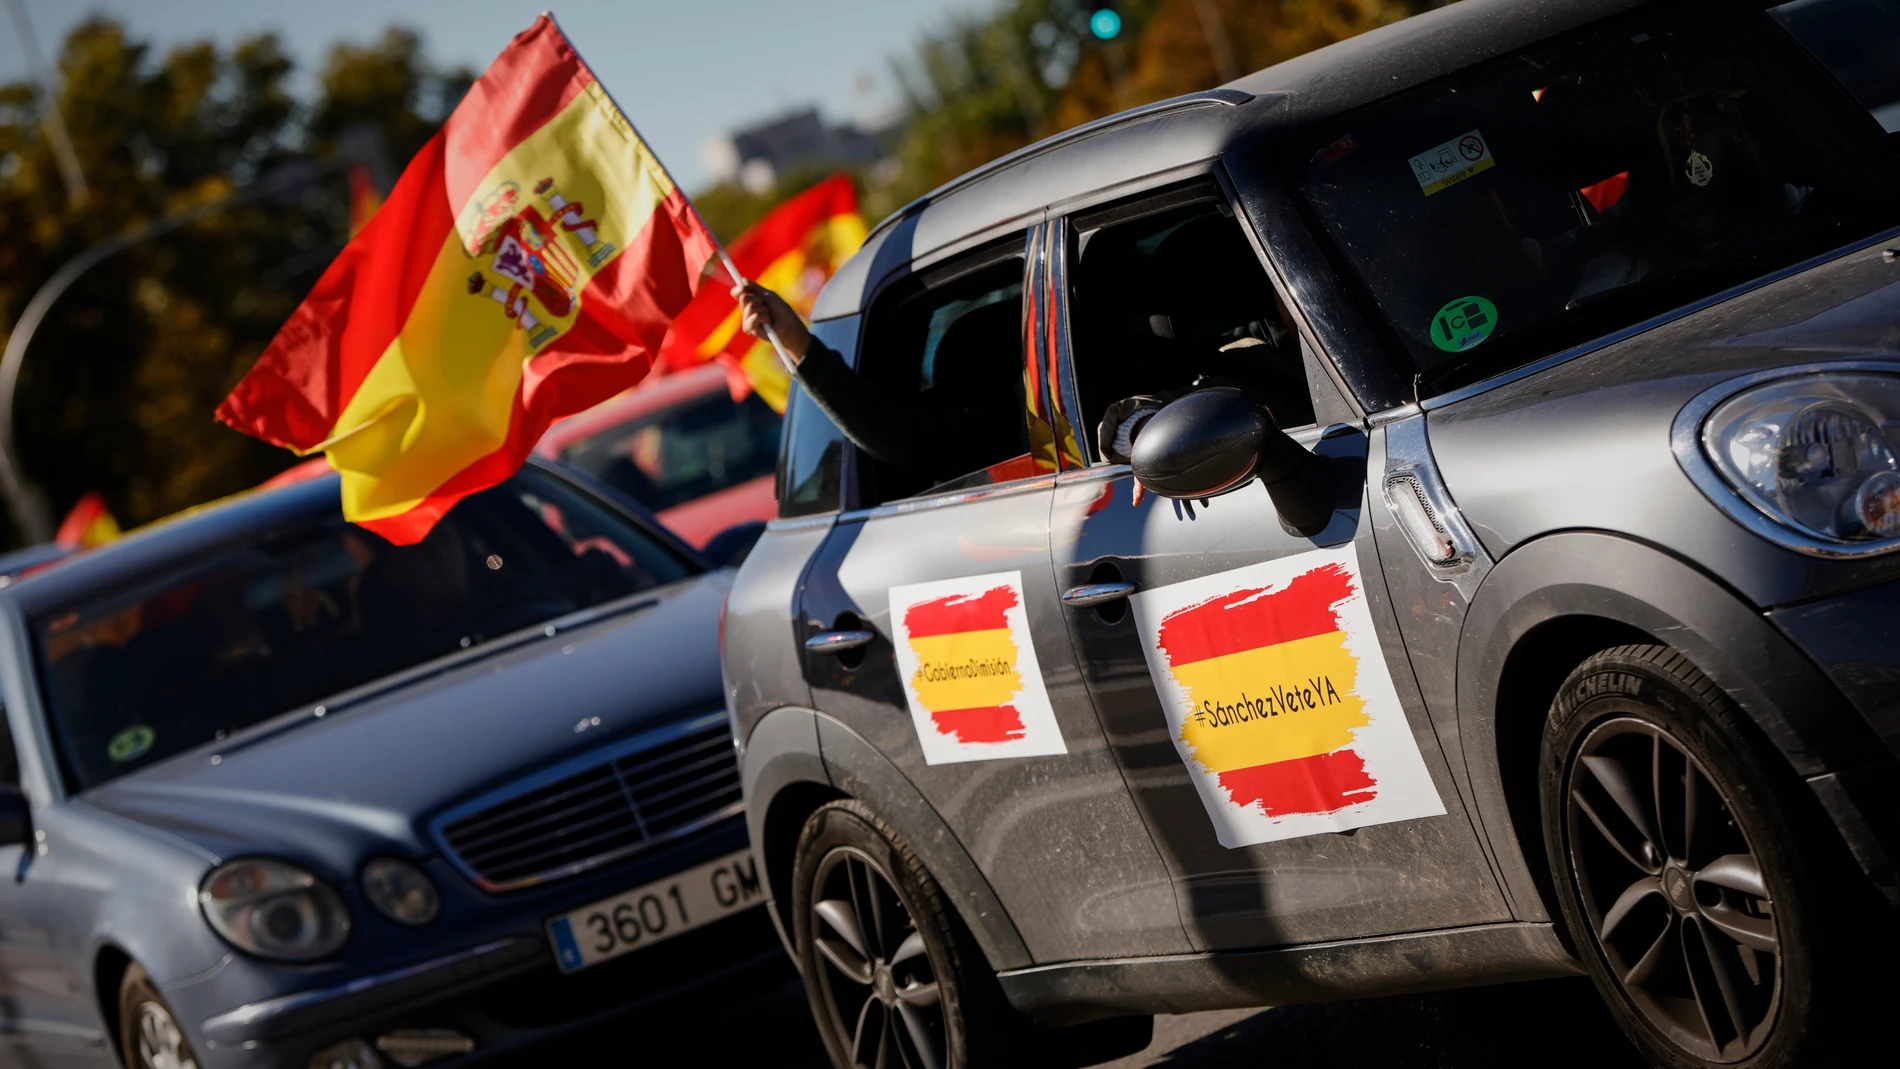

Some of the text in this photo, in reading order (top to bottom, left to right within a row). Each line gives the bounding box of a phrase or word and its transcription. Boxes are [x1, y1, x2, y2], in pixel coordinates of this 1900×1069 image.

[1441, 171, 1466, 187] AIRBAG
[916, 658, 1011, 682] #GobiernoDimisión
[1194, 675, 1341, 728] #SánchezVeteYA
[1558, 672, 1641, 722] MICHELIN
[586, 883, 690, 954] 3601
